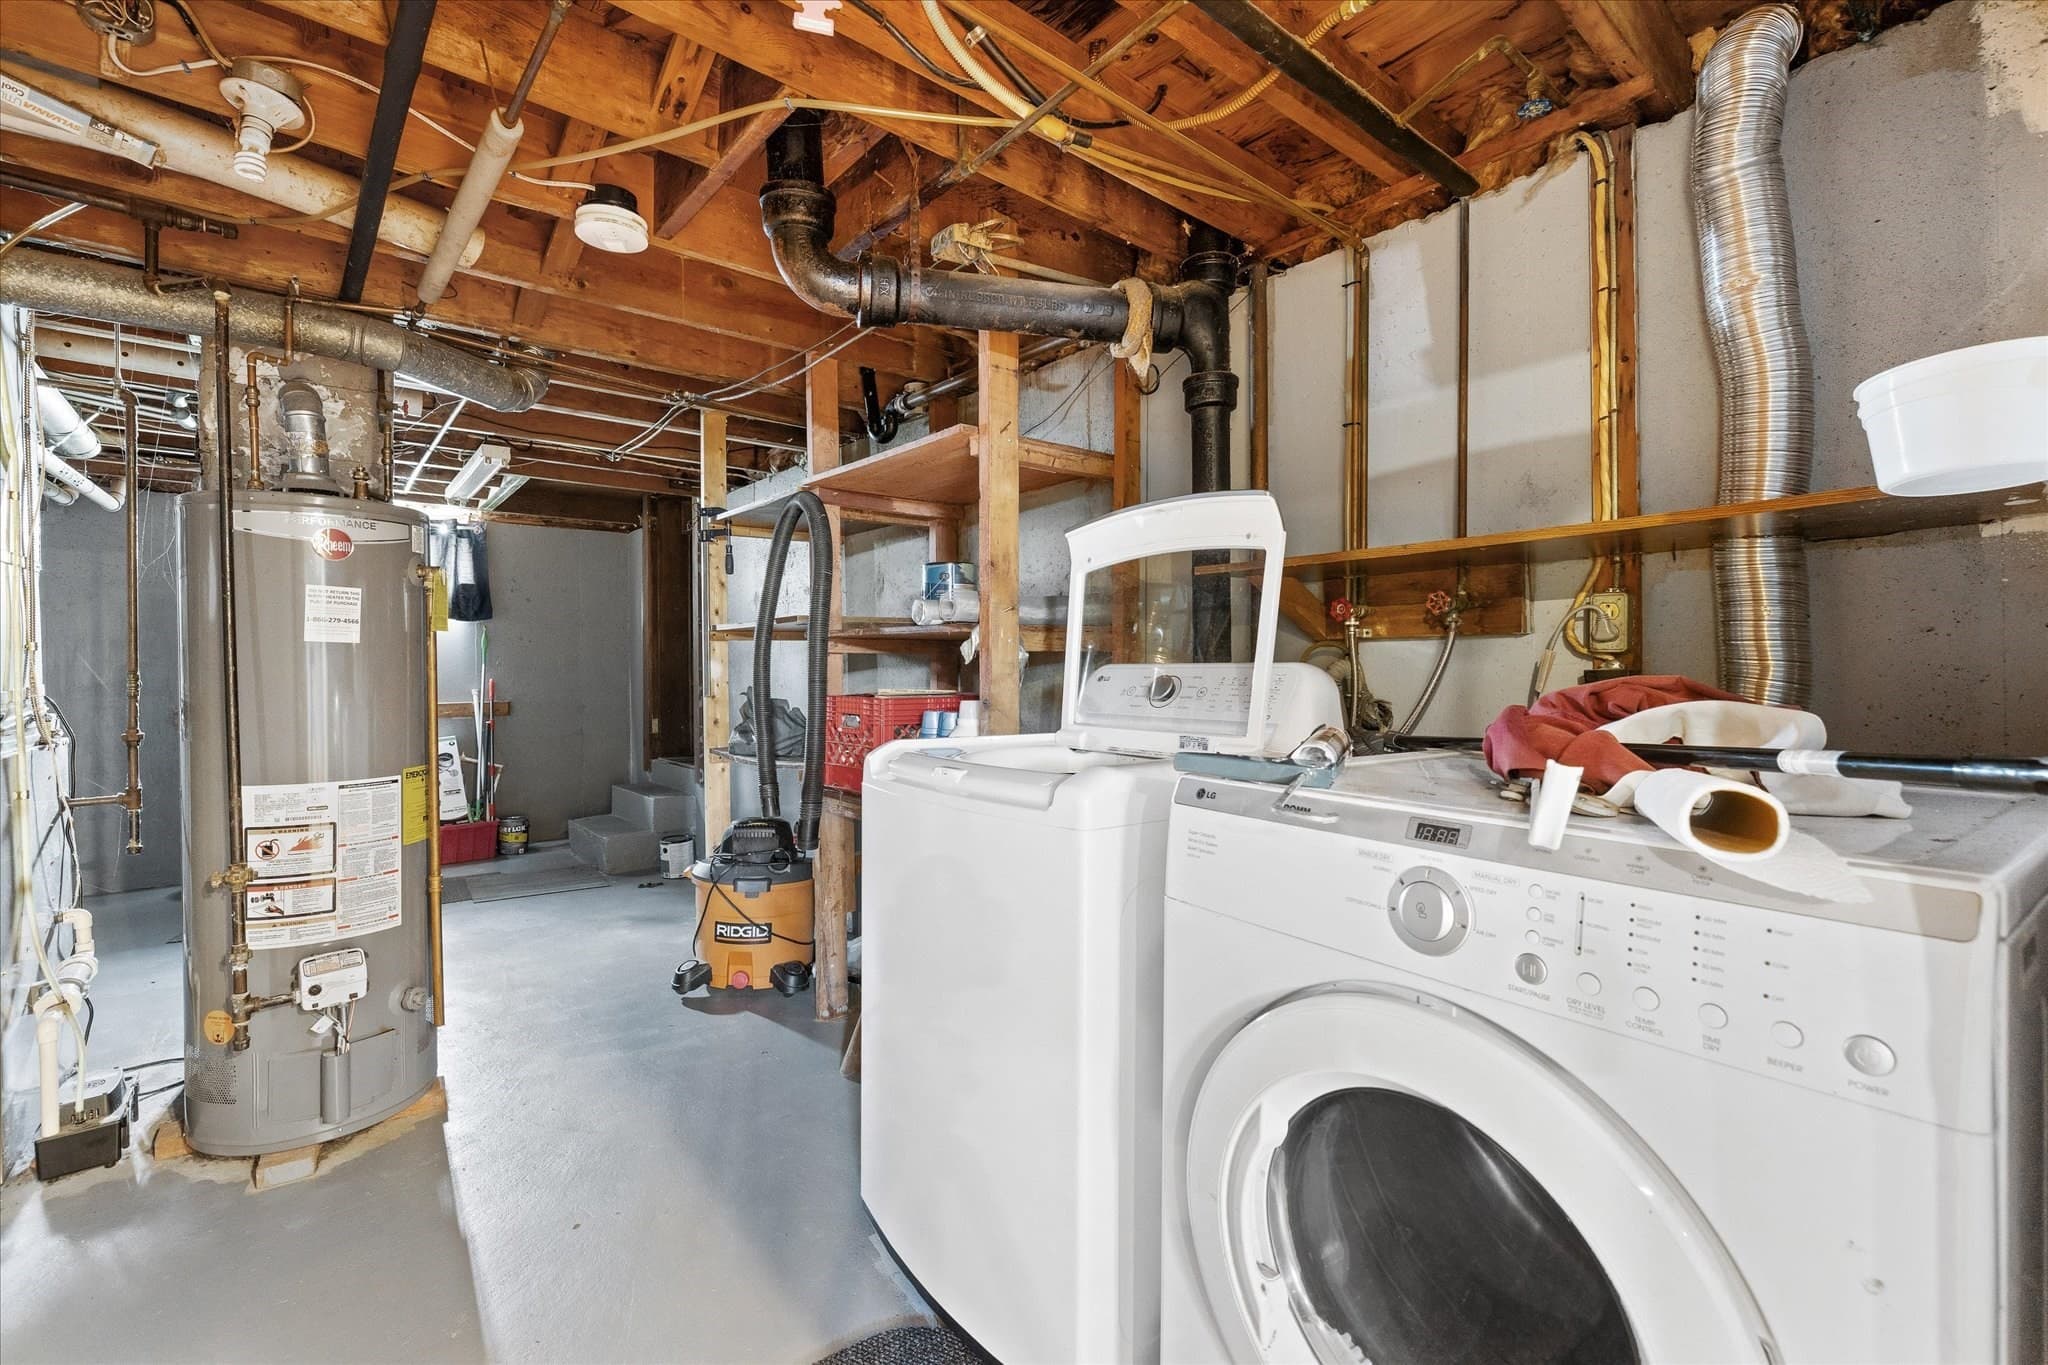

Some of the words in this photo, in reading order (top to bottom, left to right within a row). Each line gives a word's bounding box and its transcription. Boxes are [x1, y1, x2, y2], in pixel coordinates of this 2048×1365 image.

[1, 82, 25, 97] Cool
[22, 101, 82, 131] SYLVANIA
[318, 532, 352, 556] Rheem
[716, 924, 769, 937] RIDGID
[1848, 1078, 1890, 1096] POWER
